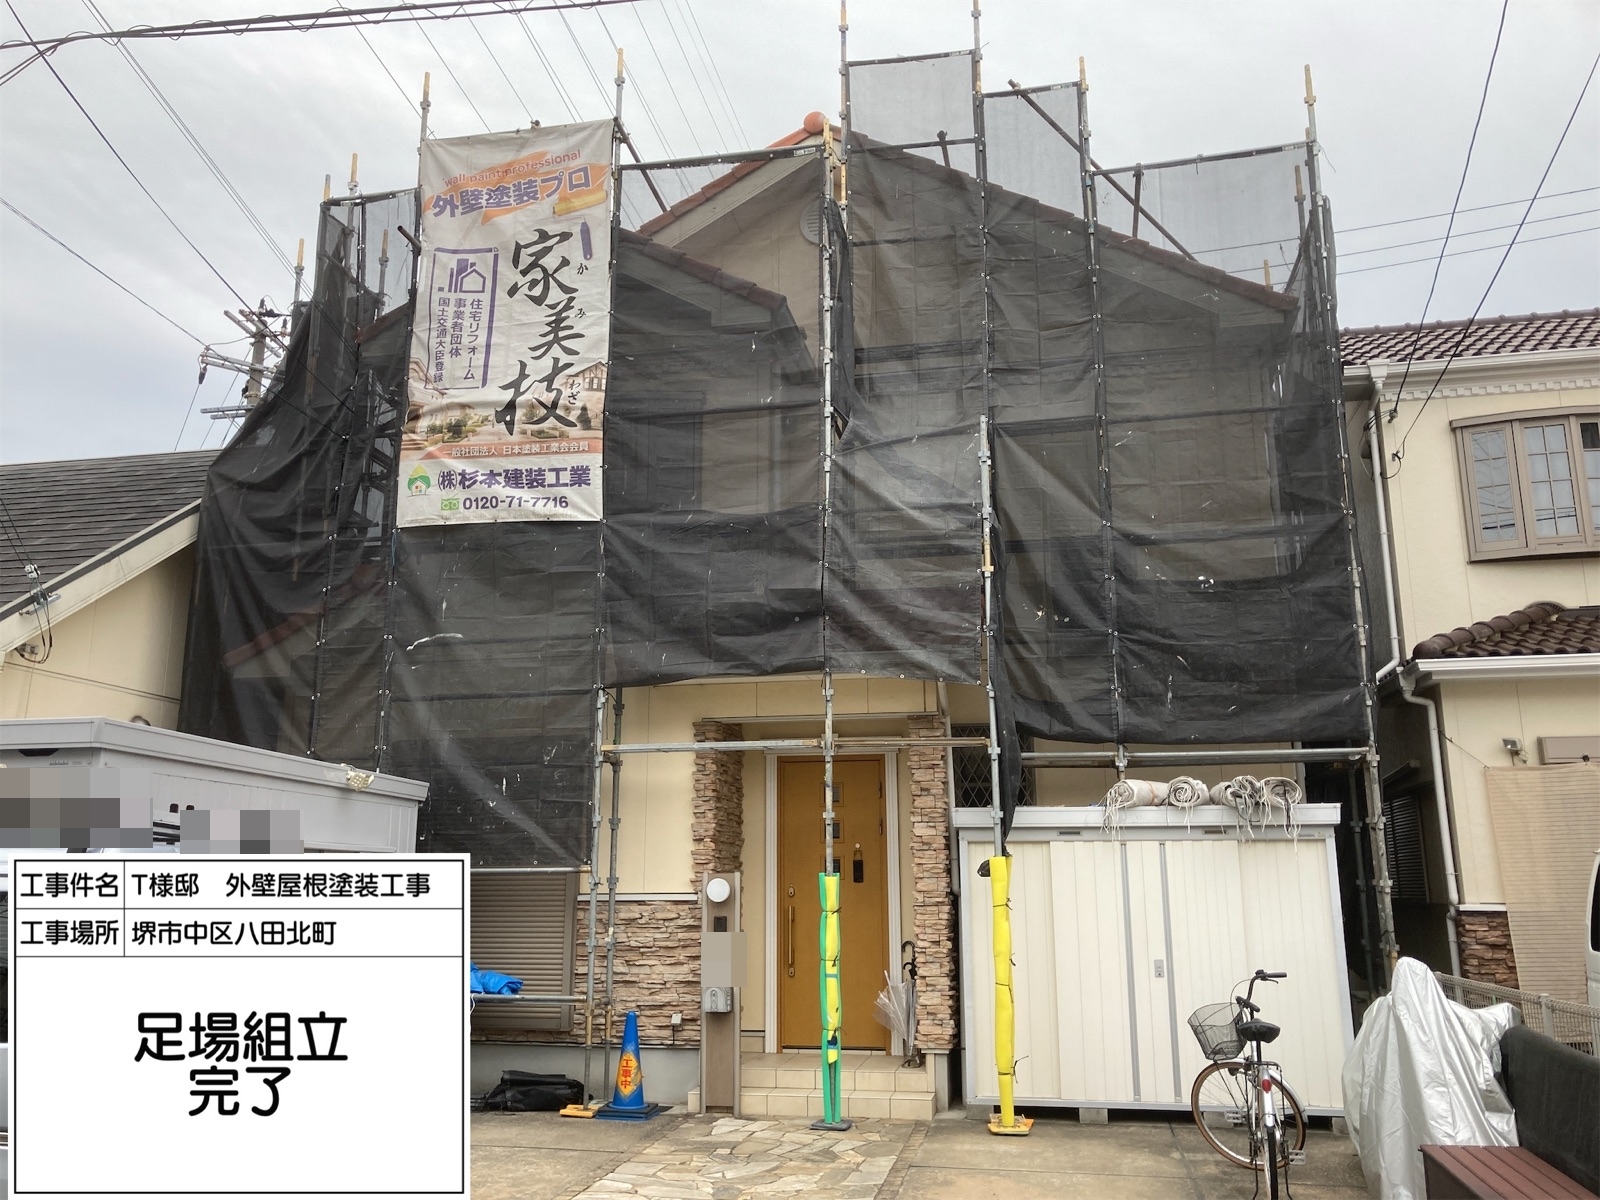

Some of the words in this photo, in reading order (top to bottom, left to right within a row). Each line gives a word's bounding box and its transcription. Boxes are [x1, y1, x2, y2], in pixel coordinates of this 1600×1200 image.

[431, 165, 592, 218] 外壁塗装プロ
[444, 173, 466, 188] wall
[469, 168, 502, 183] paint
[504, 149, 582, 178] professional
[433, 296, 450, 384] 国土交通大臣登録
[448, 298, 467, 359] 事業者団体
[462, 298, 483, 381] 住宅リフォーム
[494, 228, 586, 436] 家美技
[568, 379, 581, 406] わざ
[442, 446, 498, 457] 一般社団法人
[502, 441, 590, 455] 日本塗装工業会会員
[462, 494, 569, 511] 0120-71-7716
[620, 1059, 632, 1088] 工事中
